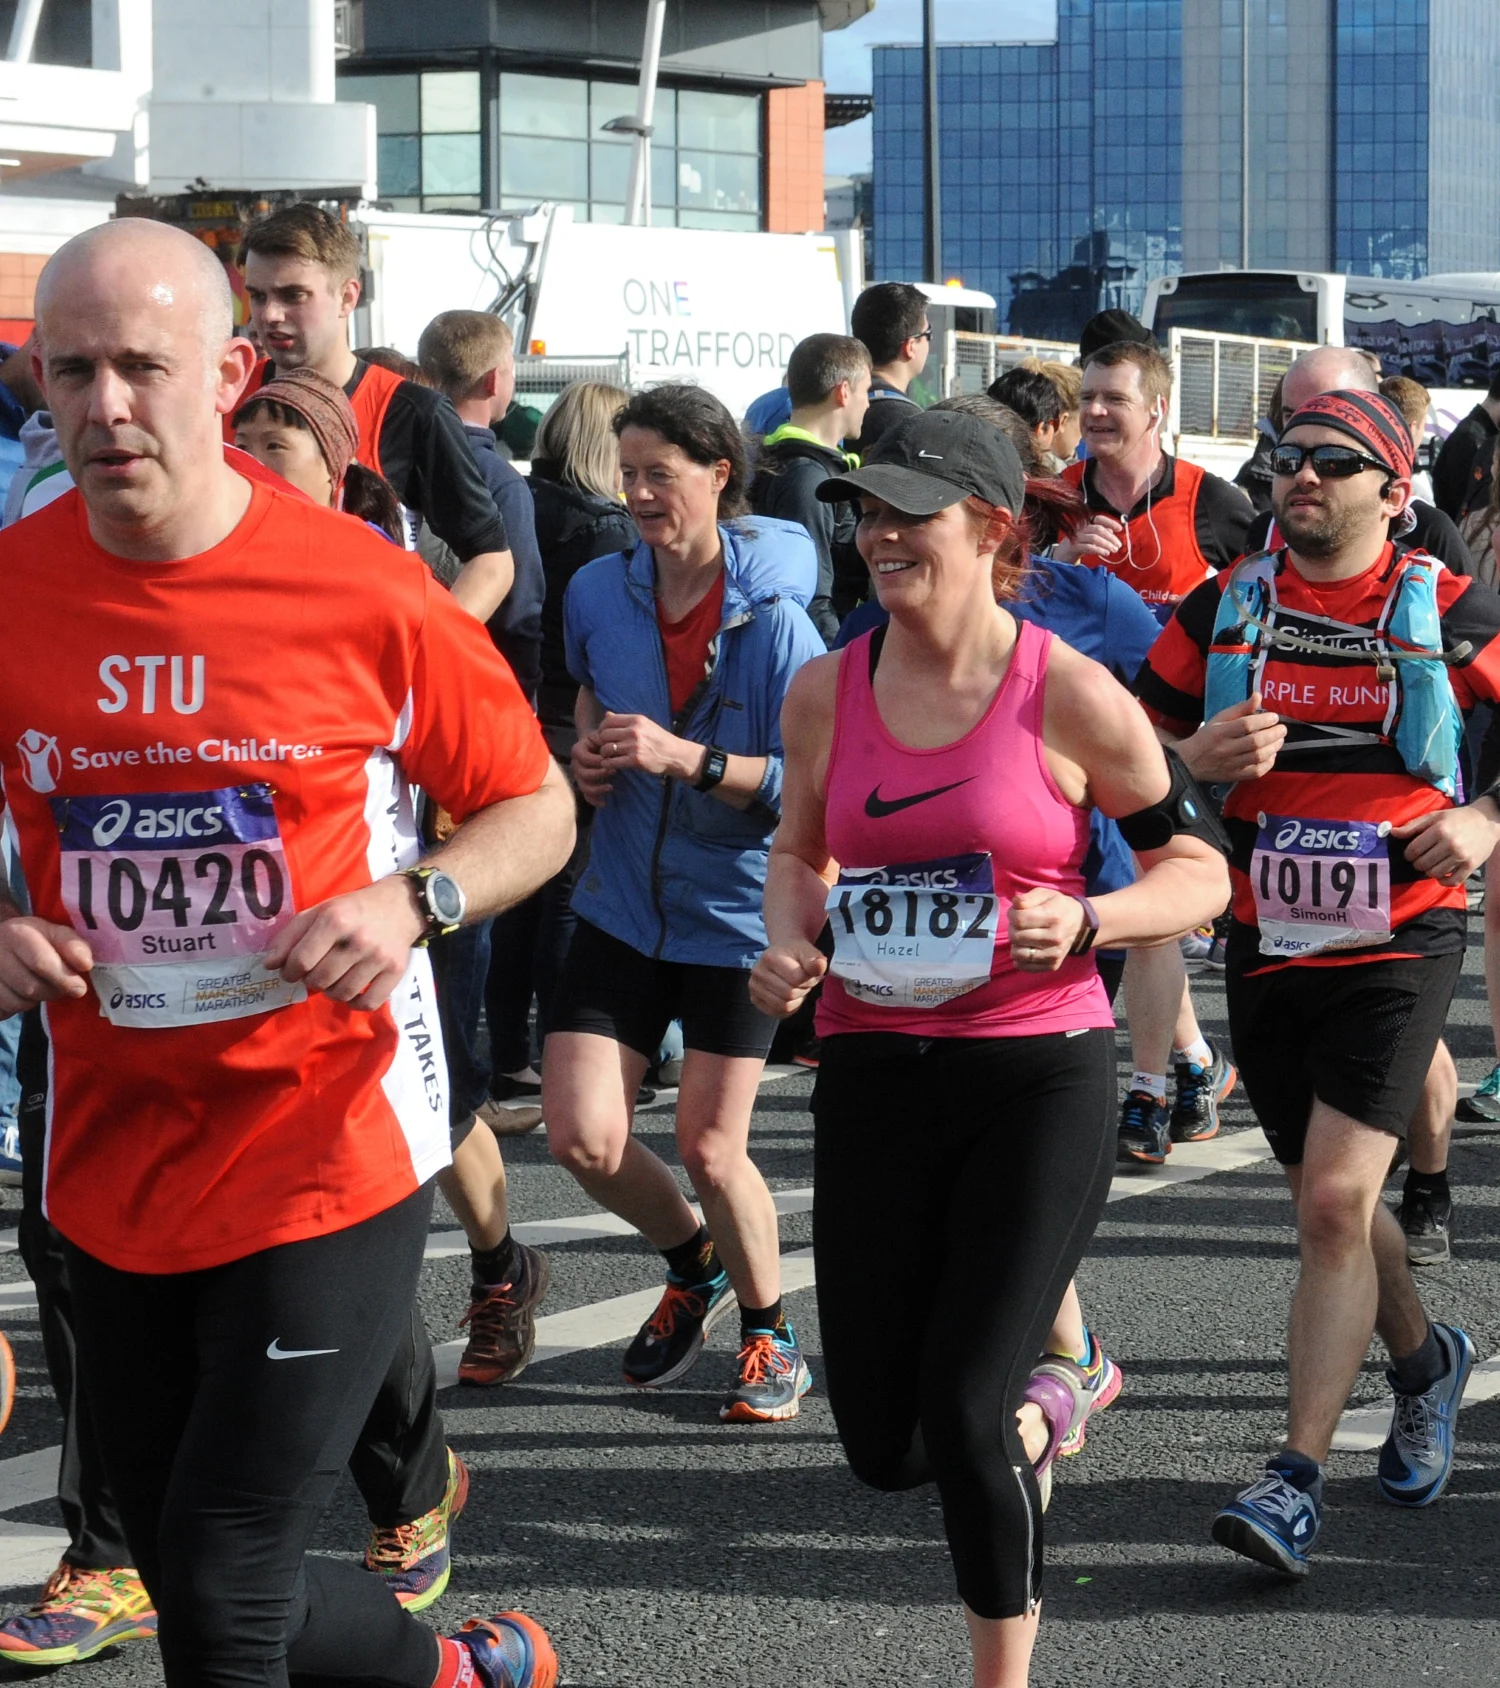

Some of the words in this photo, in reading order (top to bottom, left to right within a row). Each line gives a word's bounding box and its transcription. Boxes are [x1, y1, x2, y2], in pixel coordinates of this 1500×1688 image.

[623, 278, 692, 316] ONE
[627, 329, 798, 368] TRAFFORD
[97, 655, 205, 714] STU
[1329, 686, 1389, 705] RUNN
[70, 747, 140, 770] Save
[145, 741, 192, 764] the
[78, 849, 283, 931] 10420
[1260, 855, 1378, 909] 10191
[838, 888, 994, 938] 18182
[1290, 907, 1347, 922] SimonH
[142, 932, 216, 954] Stuart
[877, 942, 920, 957] Hazel
[195, 978, 280, 1001] MANCHESTER
[196, 973, 252, 991] GREATER
[914, 977, 953, 987] GREATER
[914, 984, 974, 995] MANCHESTER
[194, 991, 265, 1013] MARATHON
[404, 1013, 443, 1113] TAKES
